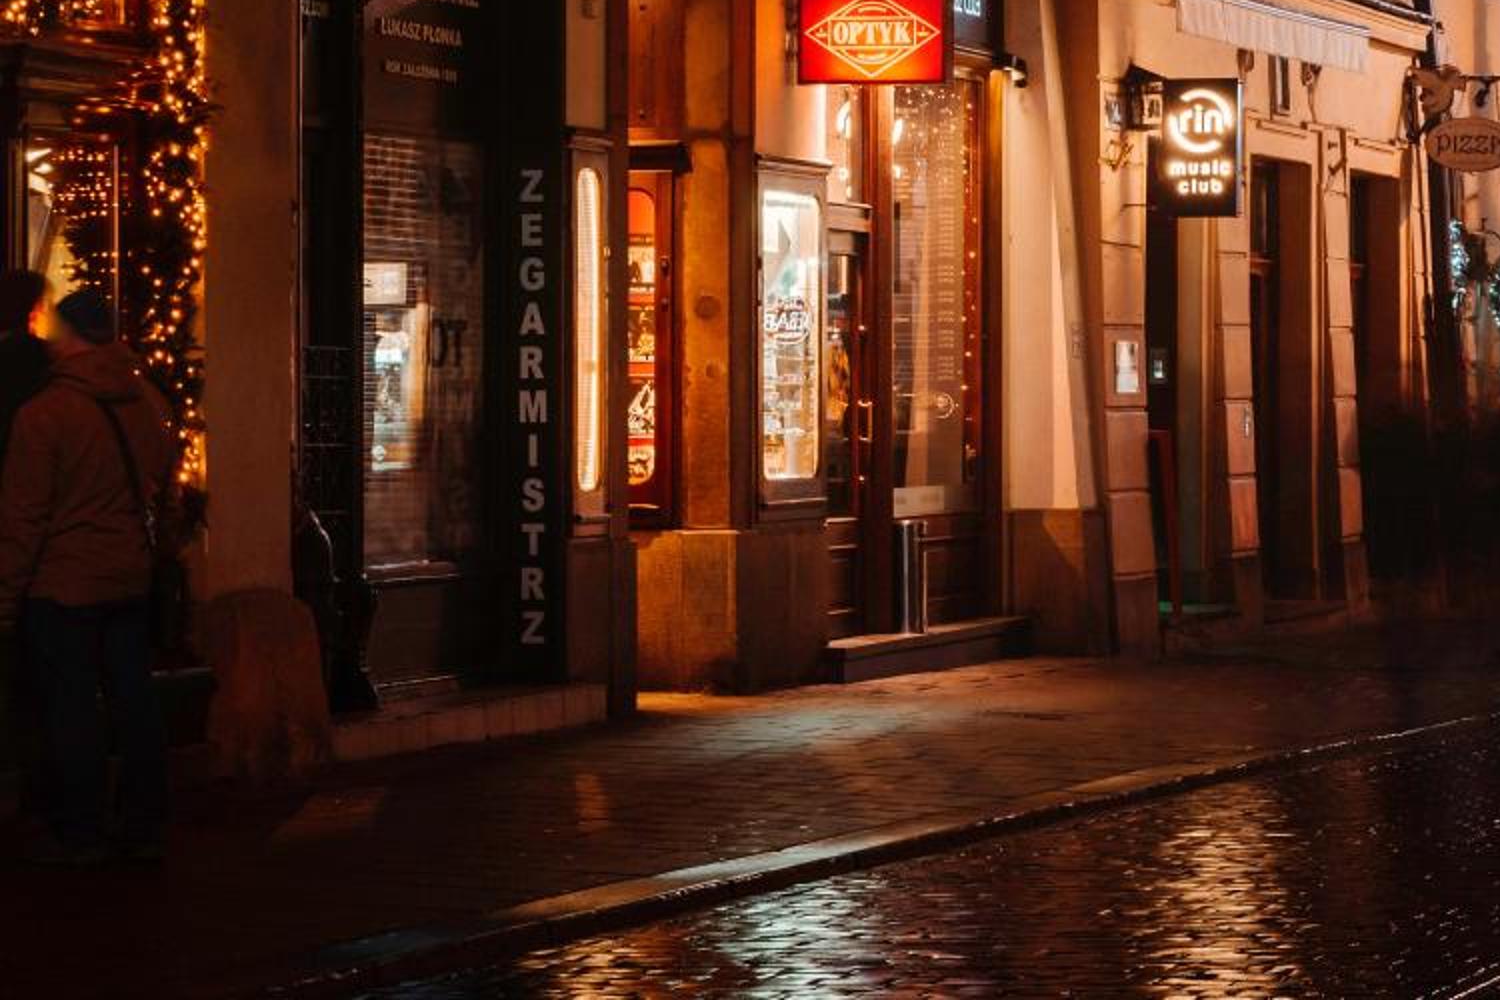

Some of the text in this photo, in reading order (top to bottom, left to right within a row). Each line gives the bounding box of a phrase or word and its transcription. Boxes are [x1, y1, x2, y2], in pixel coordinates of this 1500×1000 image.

[832, 20, 912, 45] OPTYK
[1178, 103, 1225, 135] rin
[1167, 160, 1232, 177] music
[1177, 178, 1224, 194] club
[518, 169, 547, 646] ZEGARMISTRZ
